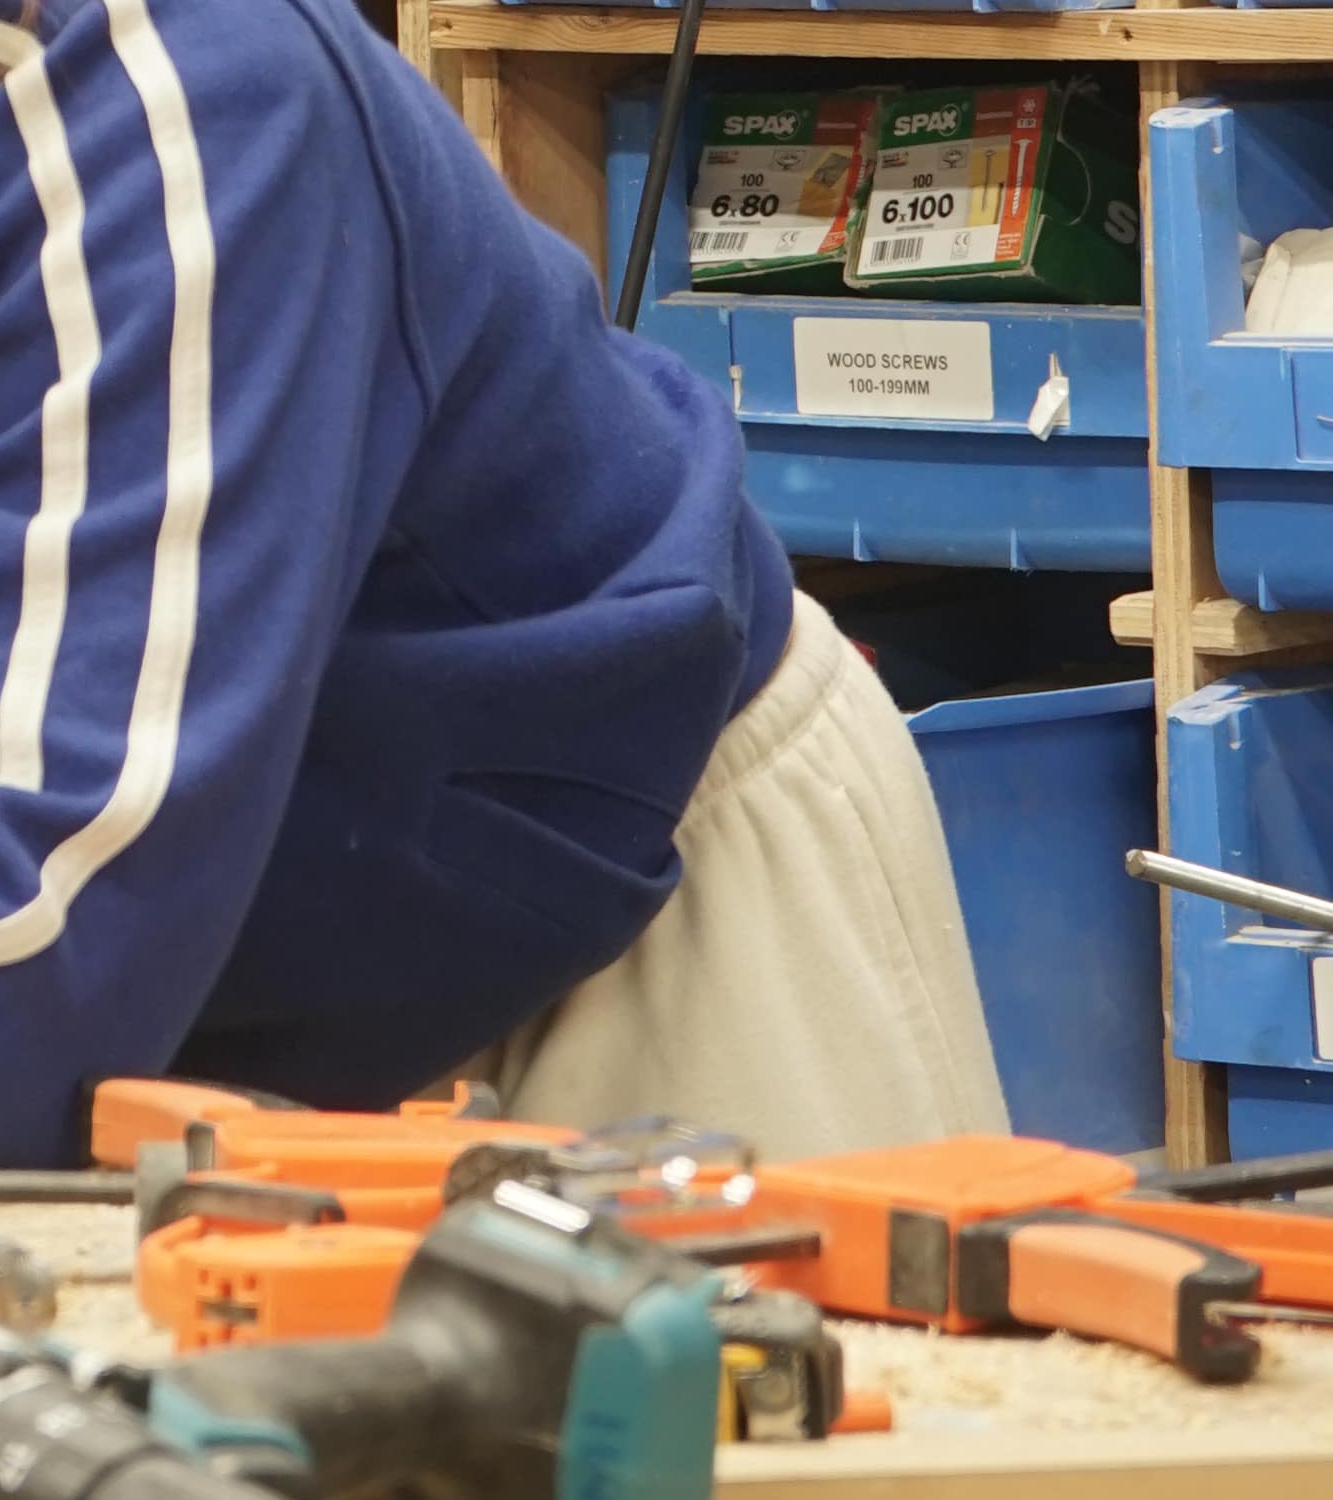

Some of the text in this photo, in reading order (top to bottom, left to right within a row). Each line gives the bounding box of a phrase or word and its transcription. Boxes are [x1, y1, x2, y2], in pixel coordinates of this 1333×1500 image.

[723, 112, 799, 137] SPAX
[893, 106, 959, 136] SPAX
[740, 173, 764, 187] 100
[912, 173, 934, 188] 100
[827, 352, 949, 371] WOOD SCREWS
[849, 378, 930, 395] 100-199MM
